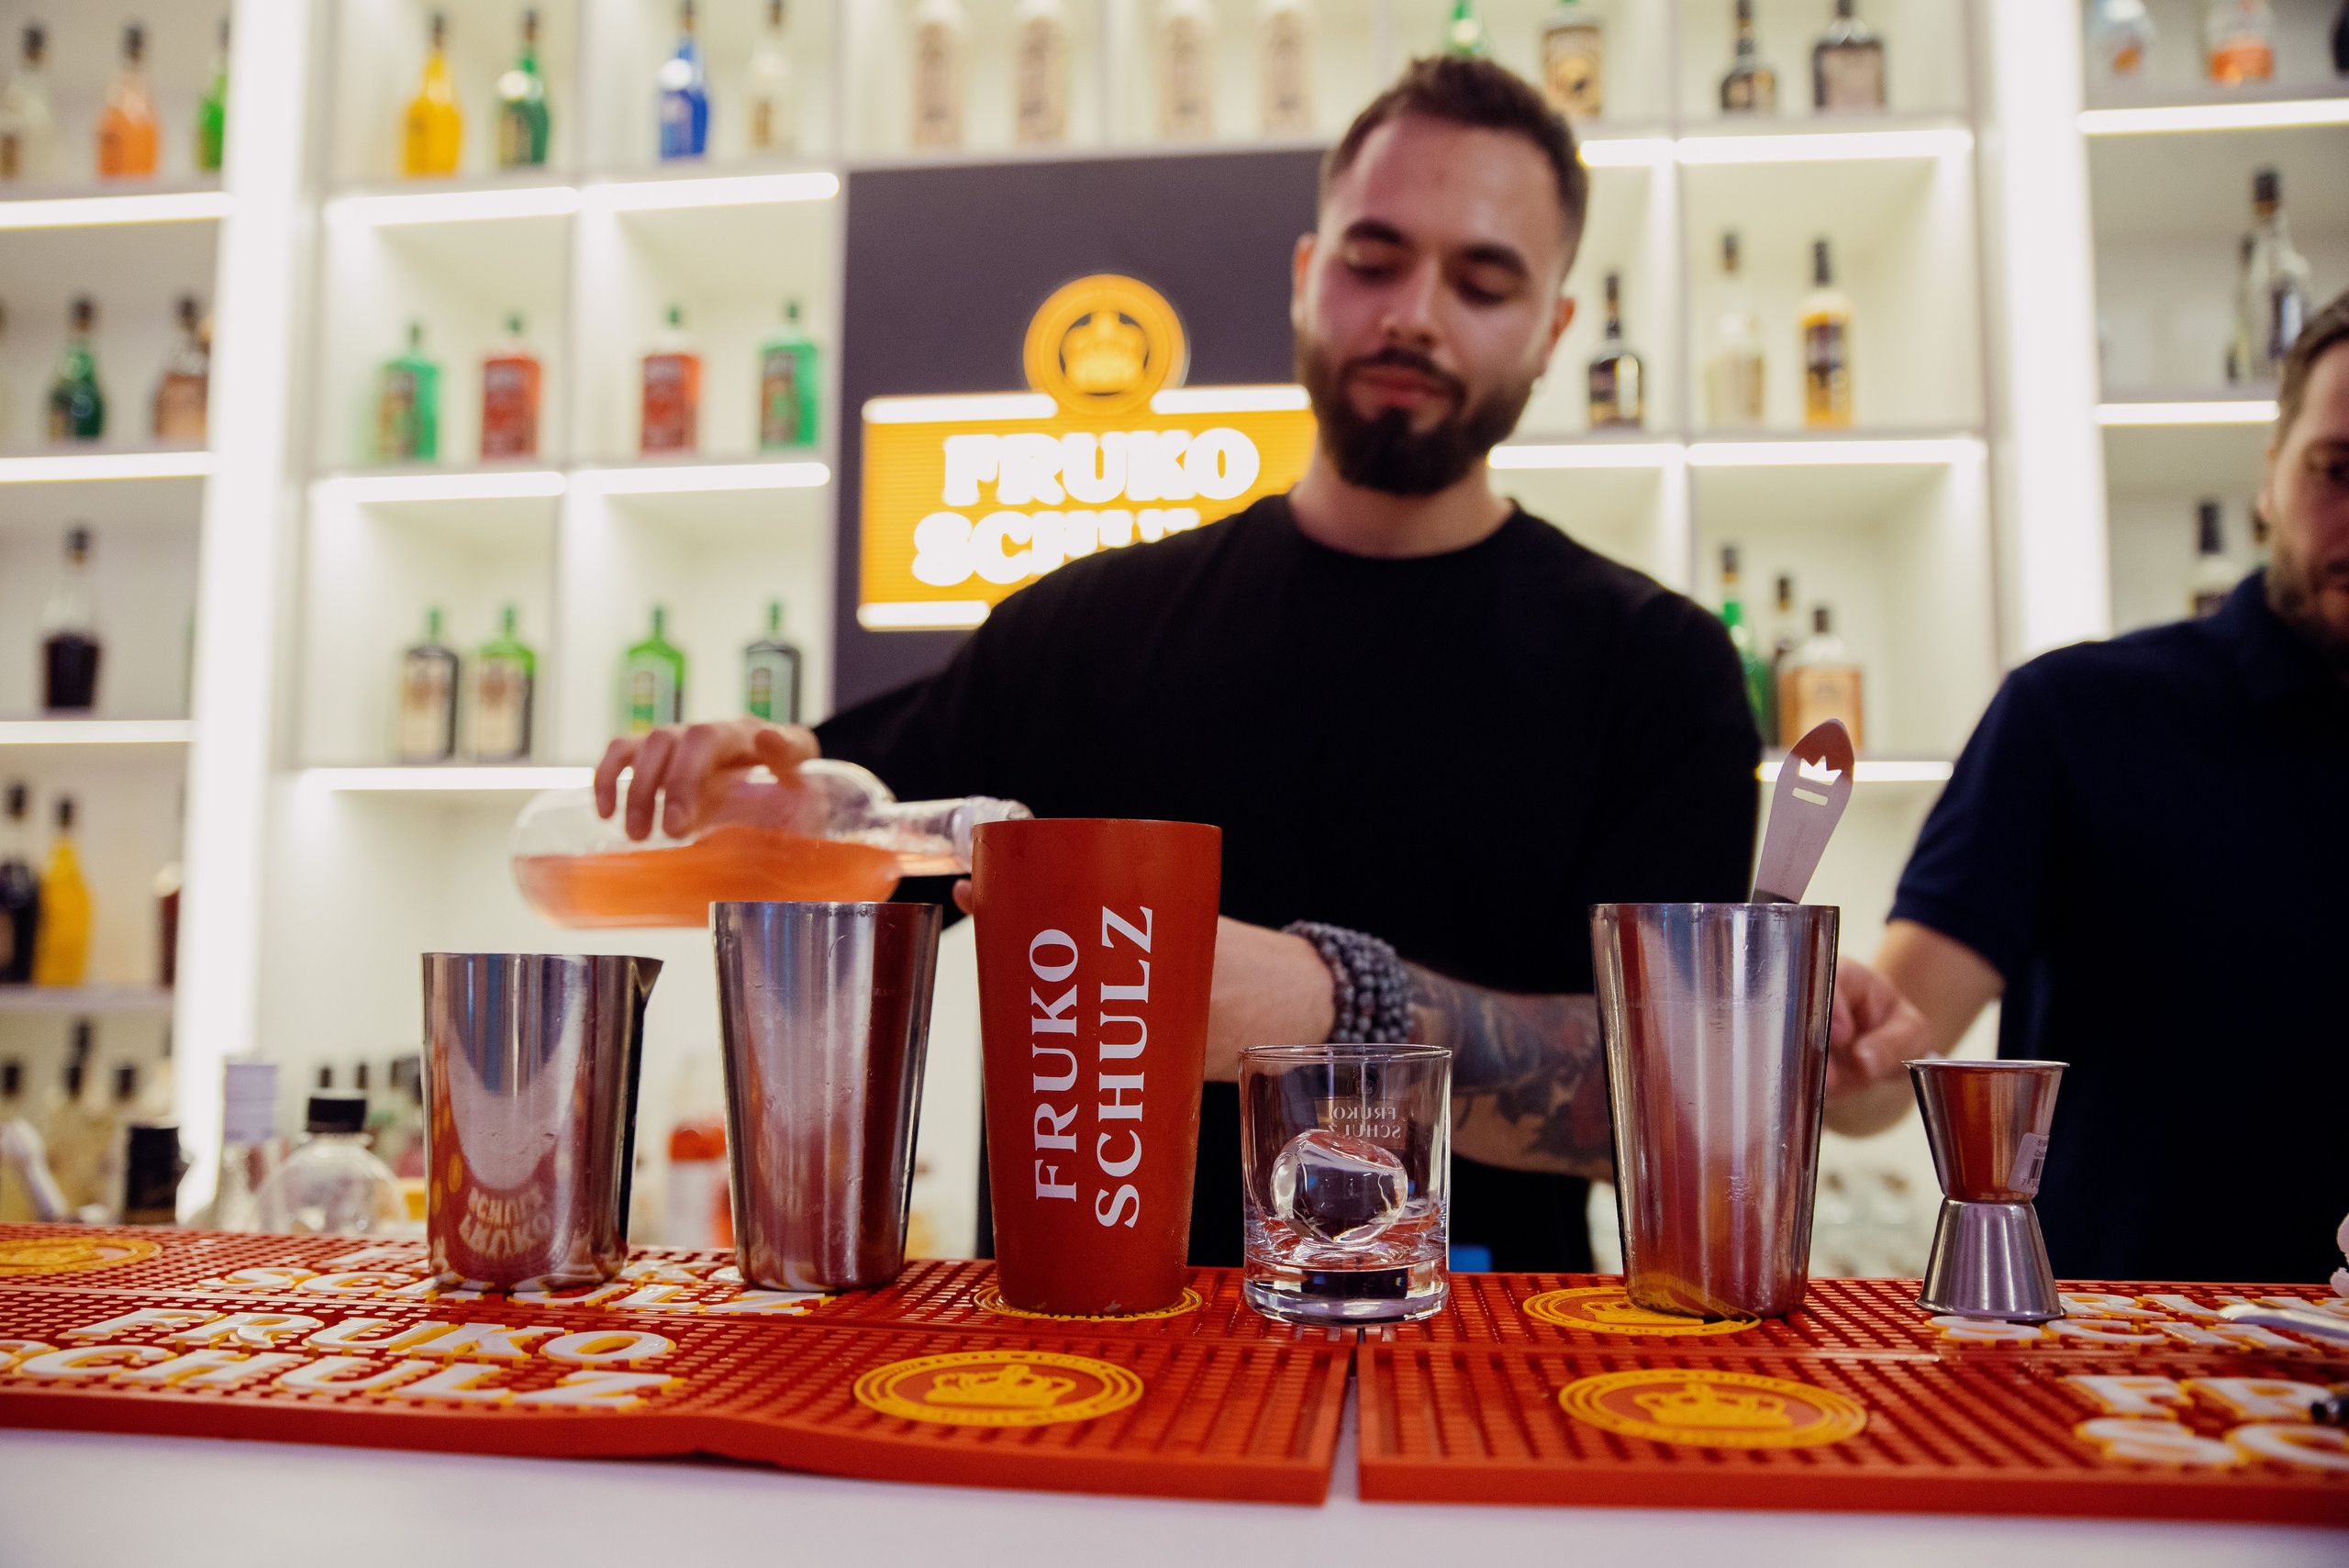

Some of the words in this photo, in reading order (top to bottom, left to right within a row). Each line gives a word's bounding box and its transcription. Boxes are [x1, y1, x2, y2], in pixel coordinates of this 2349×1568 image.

[942, 427, 1260, 506] FRUKO
[1029, 929, 1079, 1203] FRUKO
[1095, 906, 1153, 1229] SCHULZ
[68, 1307, 672, 1363] FRUKO
